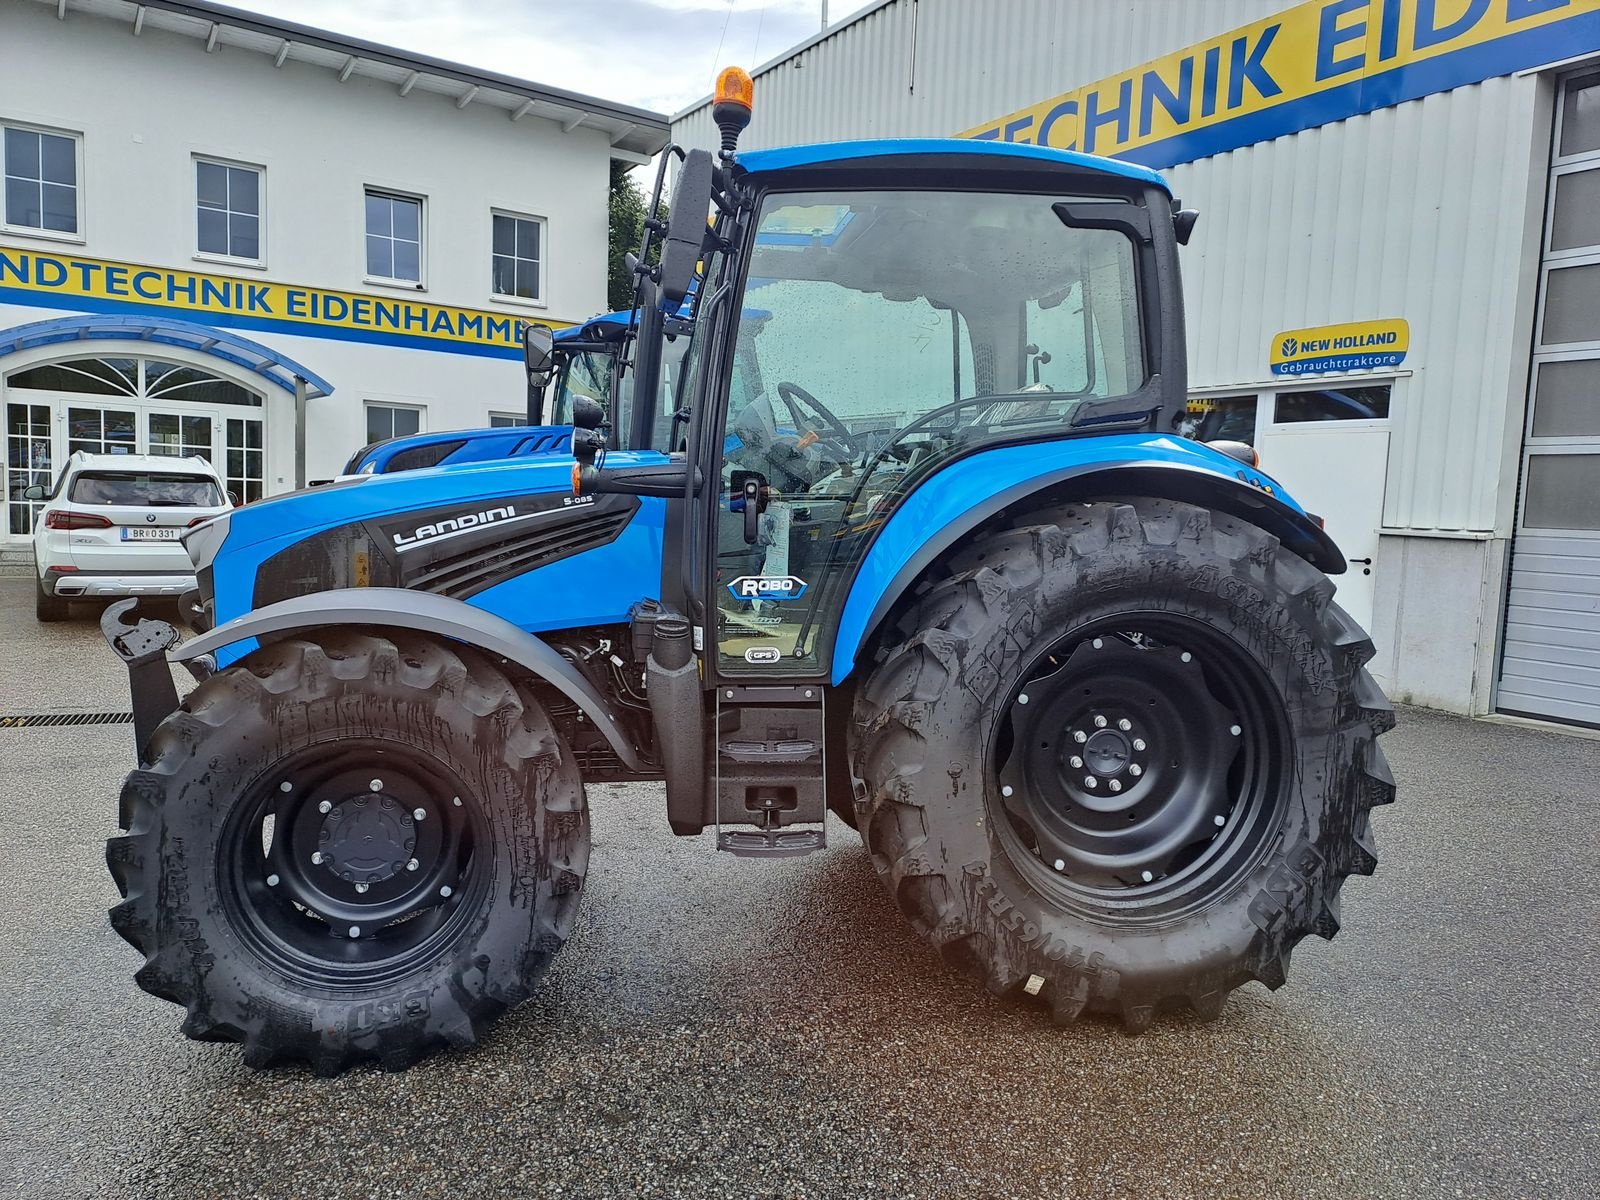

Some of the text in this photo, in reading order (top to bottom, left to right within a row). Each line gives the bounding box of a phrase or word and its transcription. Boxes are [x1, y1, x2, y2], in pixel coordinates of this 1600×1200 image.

[968, 0, 1571, 153] CHNIK EID
[0, 252, 274, 314] NDTECHNIK
[1300, 331, 1397, 353] NEW HOLLAND
[1279, 354, 1397, 374] Gebrauchttraktore
[133, 529, 145, 538] BR
[393, 505, 516, 545] LANDINI
[741, 580, 793, 597] ROBO
